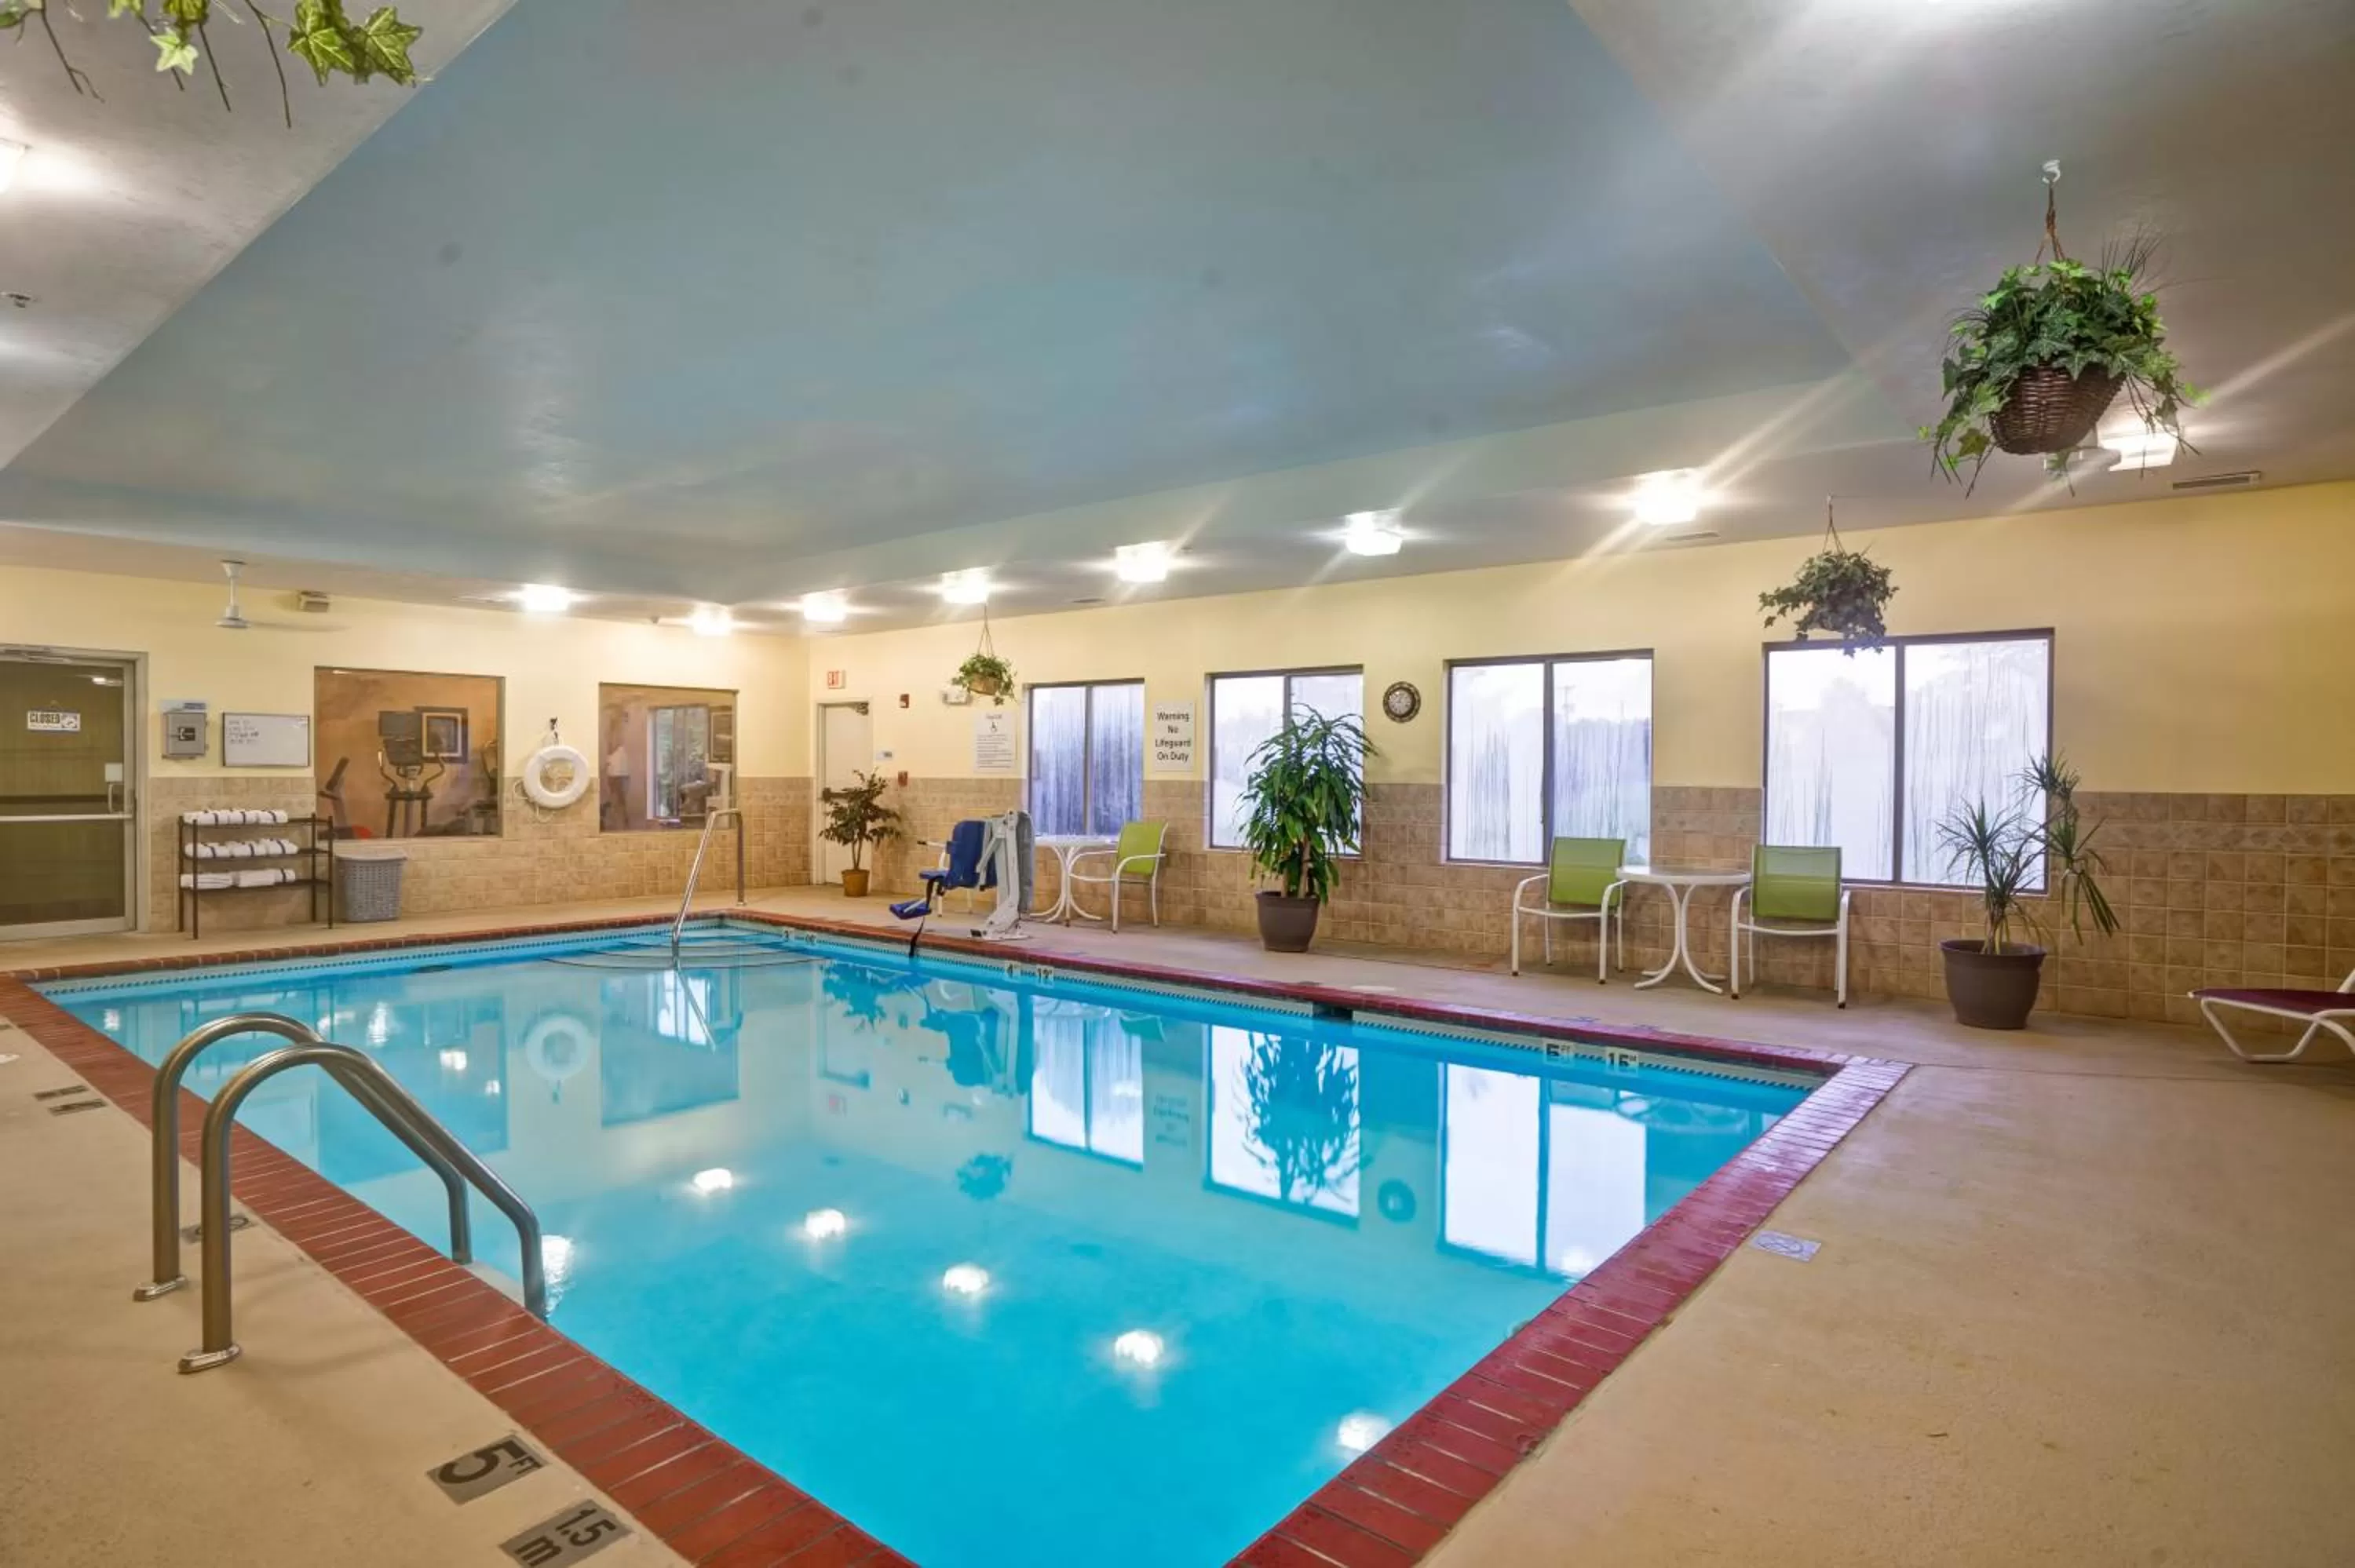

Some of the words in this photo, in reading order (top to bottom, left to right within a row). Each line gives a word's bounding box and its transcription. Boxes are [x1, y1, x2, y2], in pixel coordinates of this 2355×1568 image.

[30, 713, 60, 724] CLOSED
[1157, 712, 1189, 722] Warning
[1167, 725, 1179, 734] No
[1155, 738, 1191, 749] Lifeguard
[1157, 751, 1169, 760] On
[1170, 751, 1189, 762] Duty
[555, 1508, 616, 1548] 1.5
